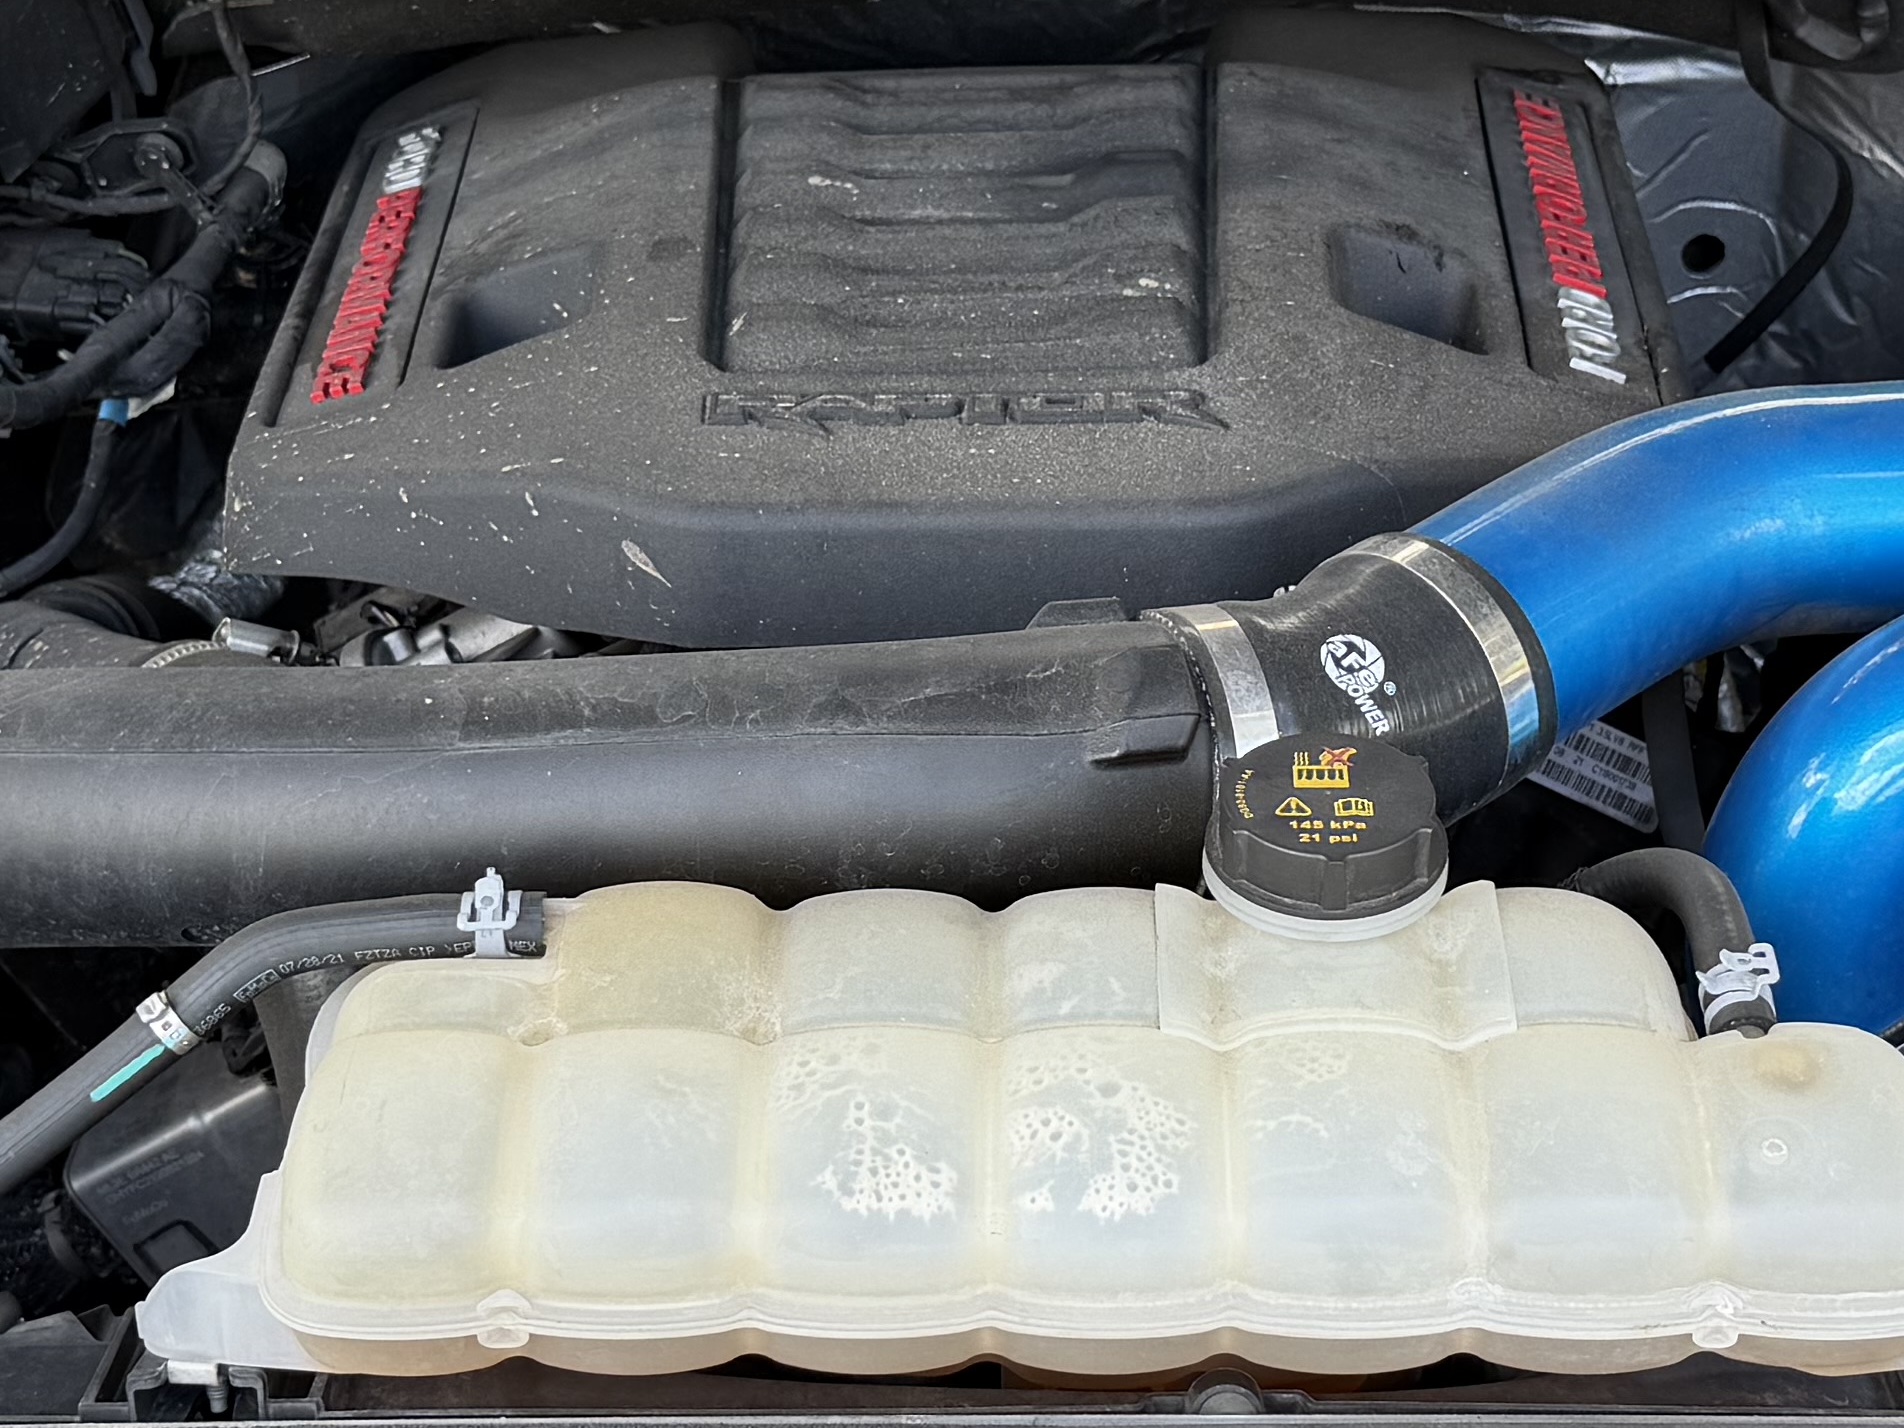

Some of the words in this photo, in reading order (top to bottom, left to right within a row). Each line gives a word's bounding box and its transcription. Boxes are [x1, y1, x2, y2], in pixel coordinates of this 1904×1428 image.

[1513, 88, 1608, 299] PERFORMANCE
[310, 186, 422, 404] PERFORMANCE
[1557, 286, 1626, 384] FORD
[701, 390, 1230, 439] RAPTOR
[1338, 674, 1391, 737] POWER
[1289, 820, 1324, 830] 145
[1330, 820, 1367, 830] kPa
[1299, 833, 1320, 843] 21
[1329, 833, 1359, 844] psi
[278, 953, 345, 975] 07/28/21
